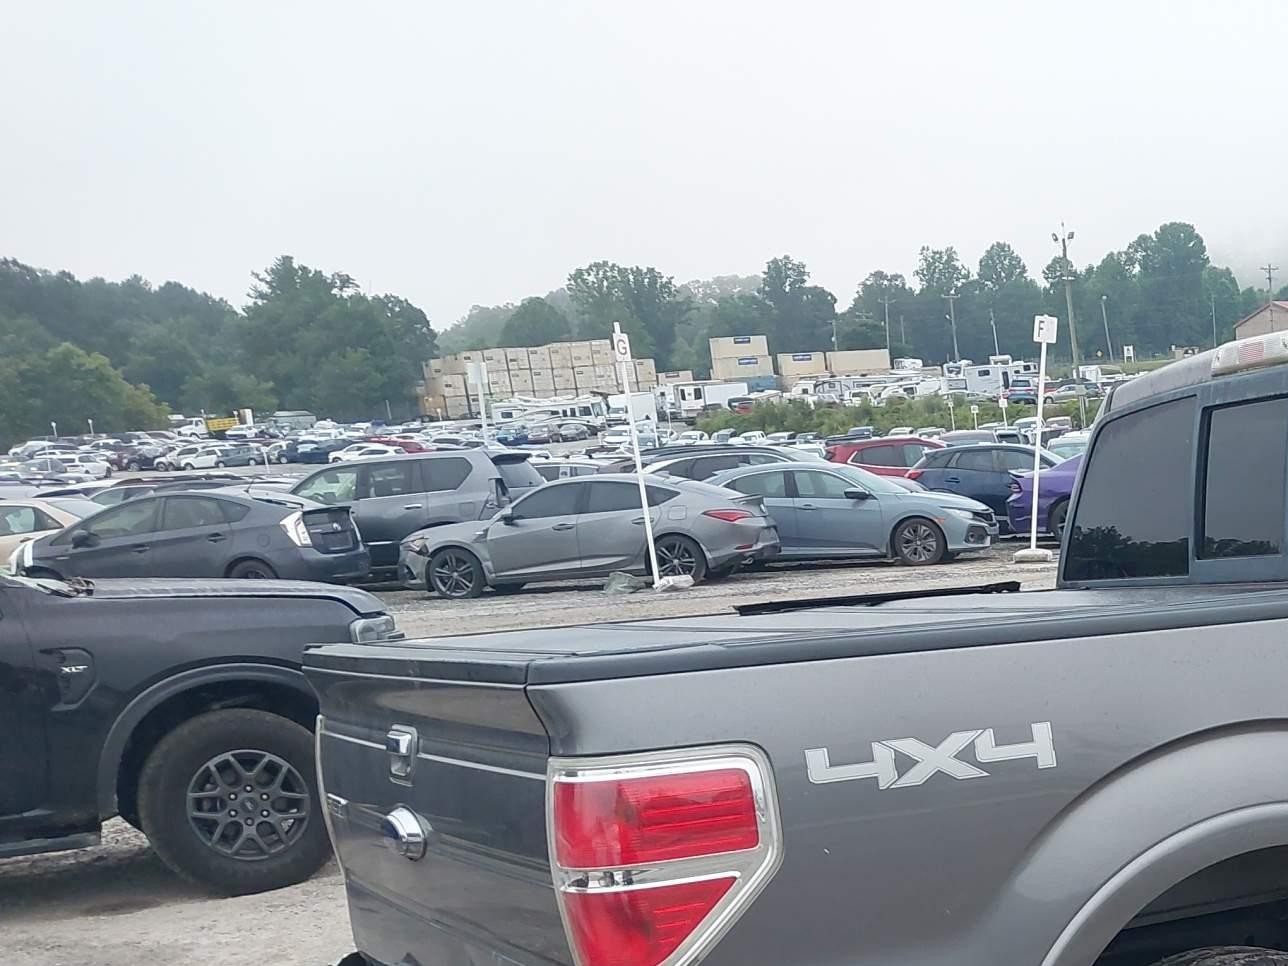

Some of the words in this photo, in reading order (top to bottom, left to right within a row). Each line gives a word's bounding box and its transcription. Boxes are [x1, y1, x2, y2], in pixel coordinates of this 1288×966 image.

[1037, 320, 1045, 337] F
[616, 338, 628, 356] G
[60, 665, 89, 673] XLT
